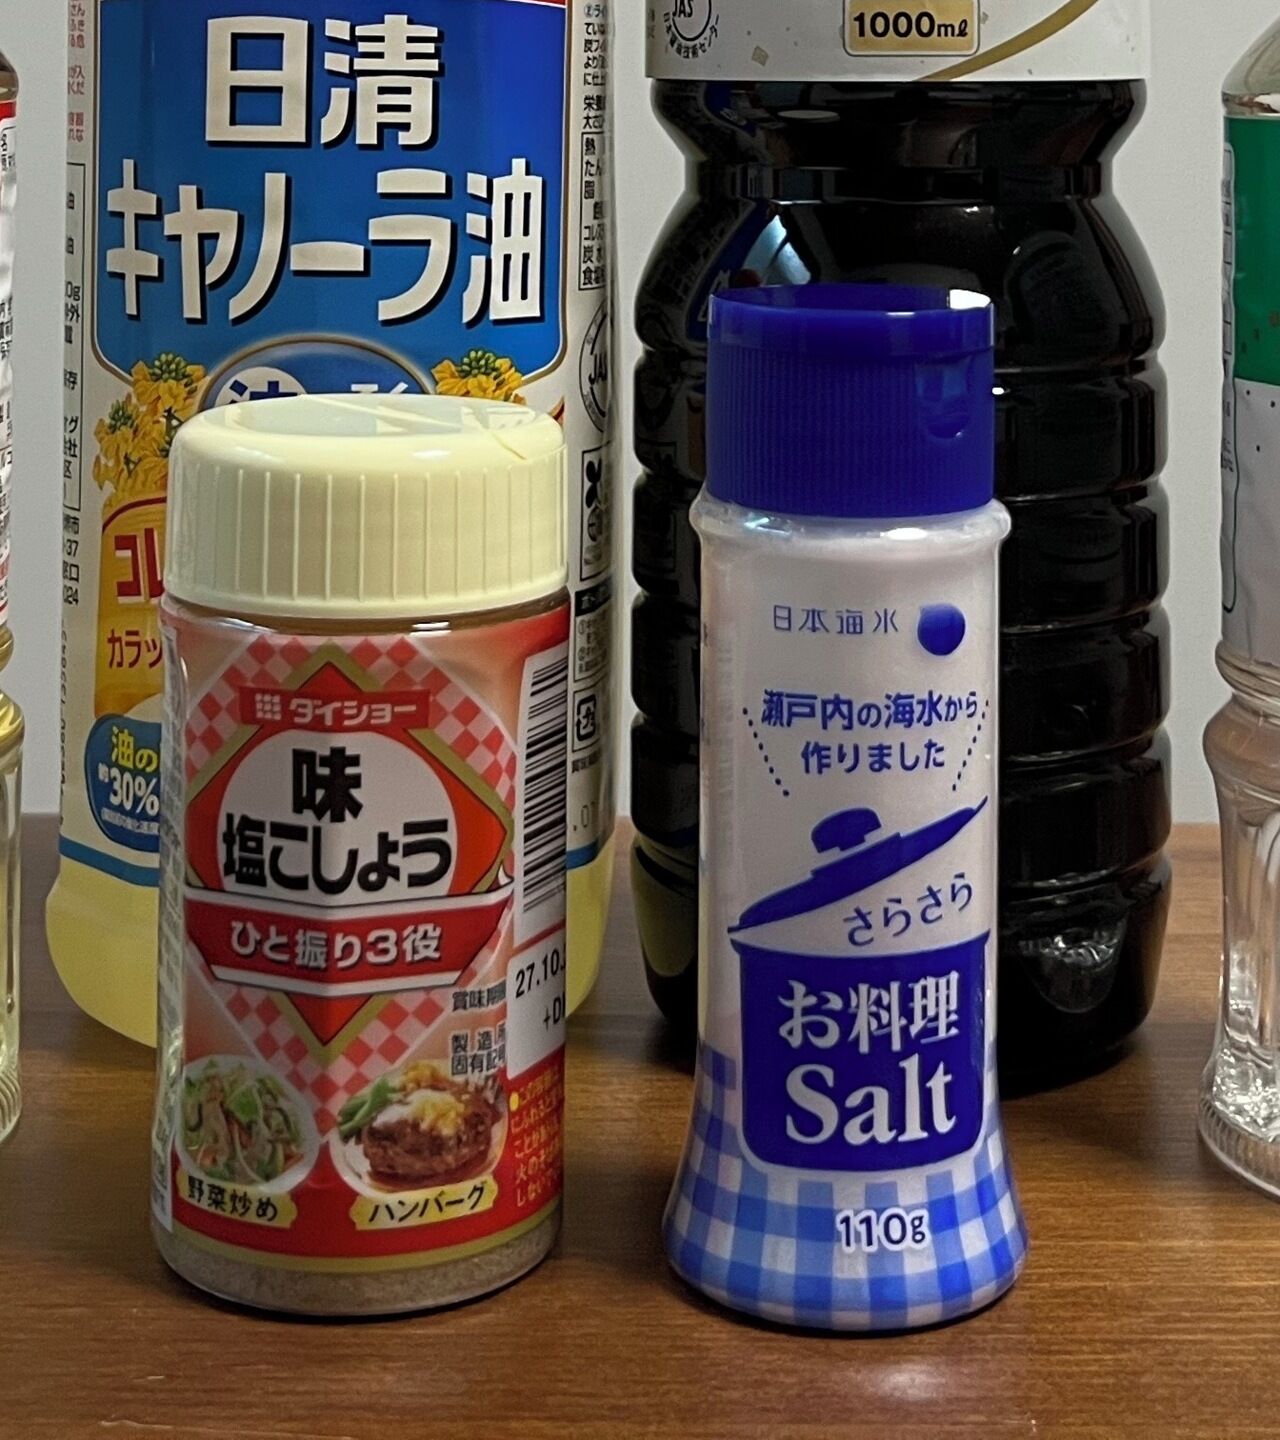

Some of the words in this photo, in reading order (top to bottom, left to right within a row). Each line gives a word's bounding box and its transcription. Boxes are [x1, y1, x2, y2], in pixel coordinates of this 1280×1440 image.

[205, 14, 440, 145] 日清
[106, 158, 543, 324] キャノーラ油
[772, 604, 899, 636] 日本海水
[107, 628, 163, 669] カラッ
[288, 697, 417, 726] ダイショー
[761, 689, 979, 731] 瀬戸内の海水から
[111, 726, 158, 773] 油の
[800, 738, 947, 775] 作りました
[292, 746, 364, 823] 味
[222, 812, 453, 895] 塩こしょう
[843, 871, 975, 948] さらさら
[231, 920, 442, 964] ひと振り3役
[776, 970, 961, 1056] お料理
[784, 1053, 957, 1147] Salt
[187, 1173, 278, 1223] 野菜炒め
[367, 1179, 488, 1223] ハンバーグ
[837, 1210, 928, 1250] 110g
